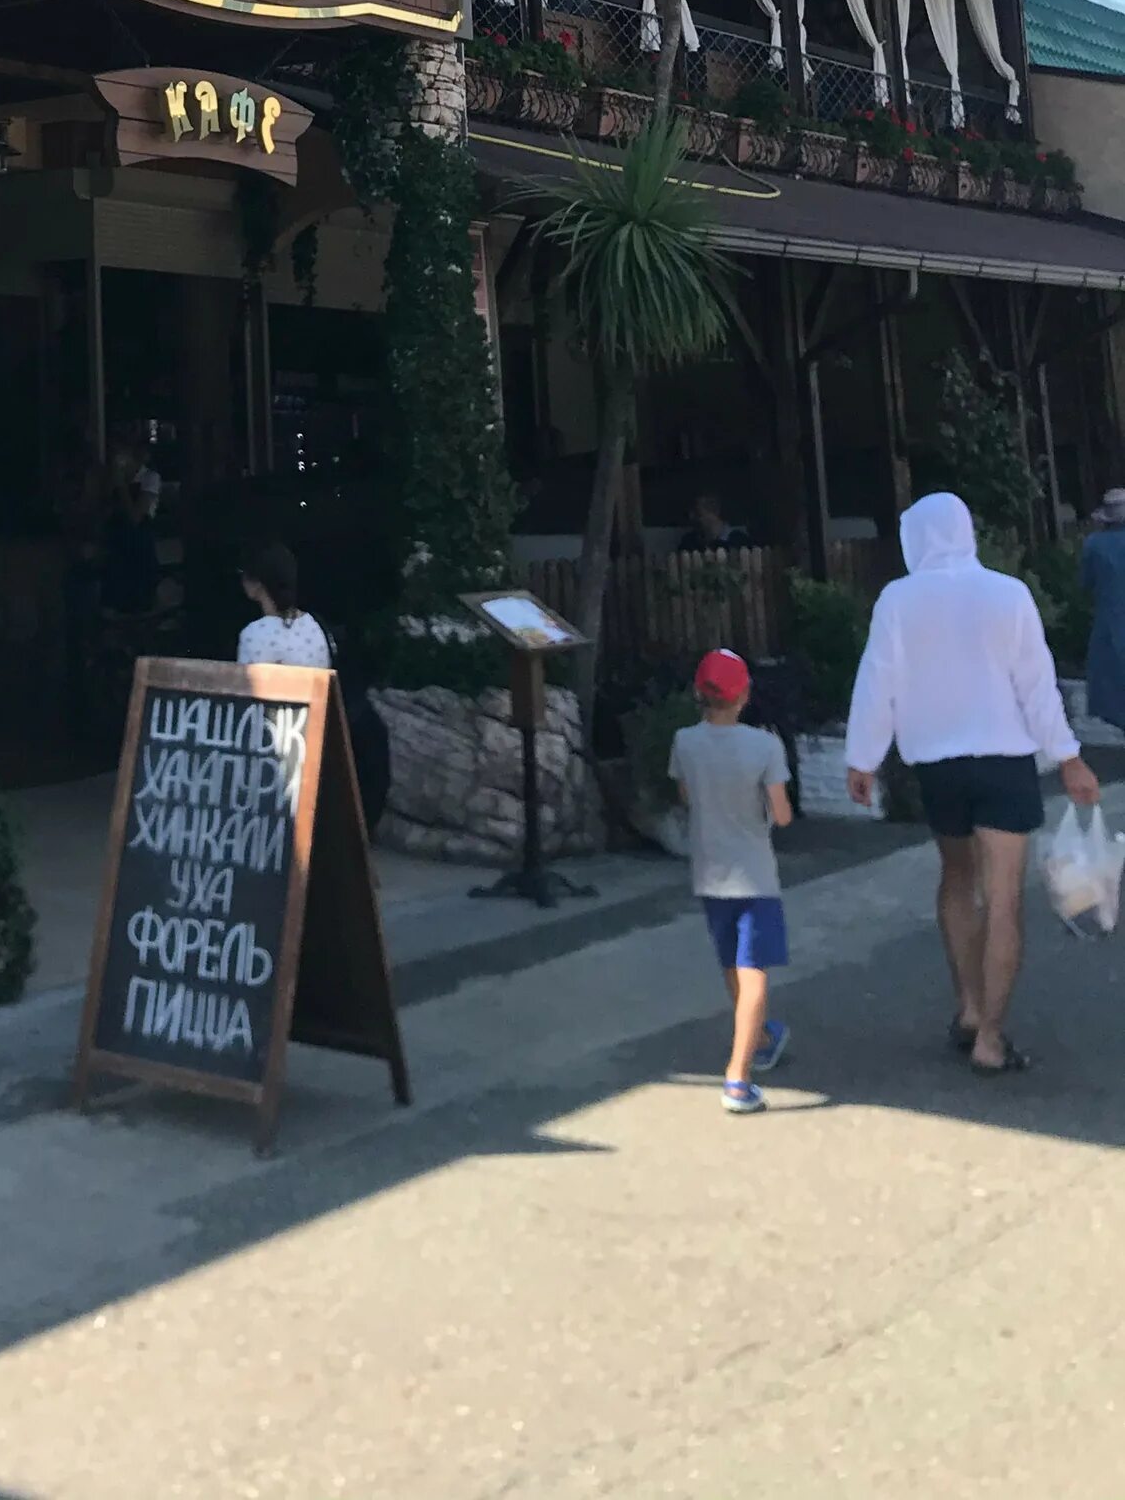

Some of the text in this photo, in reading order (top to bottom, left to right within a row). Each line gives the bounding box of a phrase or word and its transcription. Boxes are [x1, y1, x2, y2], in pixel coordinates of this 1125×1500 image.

[151, 697, 309, 762] ШАШЛЫК
[134, 745, 303, 818] ХАЧАПУРИ
[129, 803, 288, 873] ХИНКАЛИ
[166, 859, 235, 913] УХА
[127, 905, 273, 987] ФОРЕЛЬ
[123, 976, 254, 1052] ПИЦЦА
